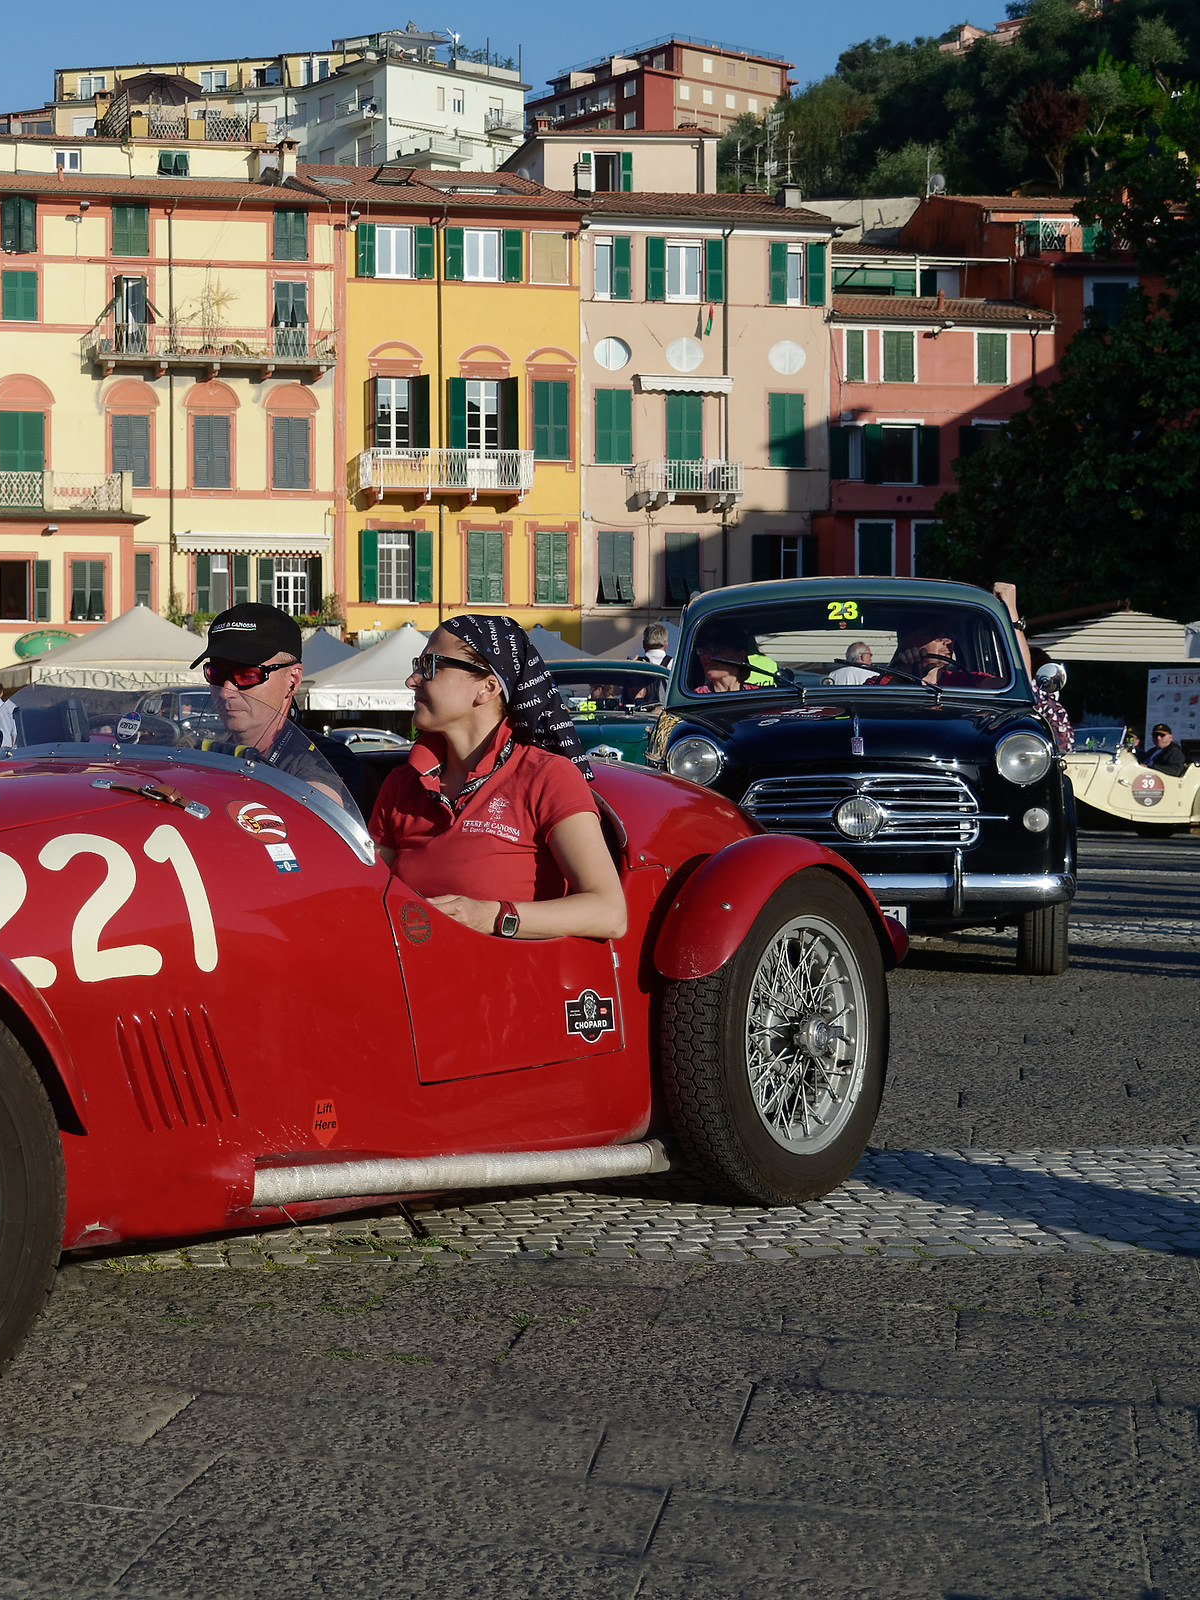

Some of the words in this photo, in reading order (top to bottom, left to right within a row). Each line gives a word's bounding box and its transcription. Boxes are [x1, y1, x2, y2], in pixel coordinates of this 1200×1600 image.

[827, 601, 858, 620] 23
[486, 619, 501, 656] GARMIN
[38, 668, 188, 691] RISTORANTE
[516, 675, 545, 691] GARMIN
[336, 694, 353, 708] La
[357, 695, 397, 709] Mano
[579, 700, 597, 712] 25
[1141, 778, 1156, 789] 39
[491, 822, 520, 837] CANOSSA
[574, 1019, 608, 1030] CHOPARD
[316, 1102, 333, 1115] Lift
[314, 1119, 337, 1131] Here
